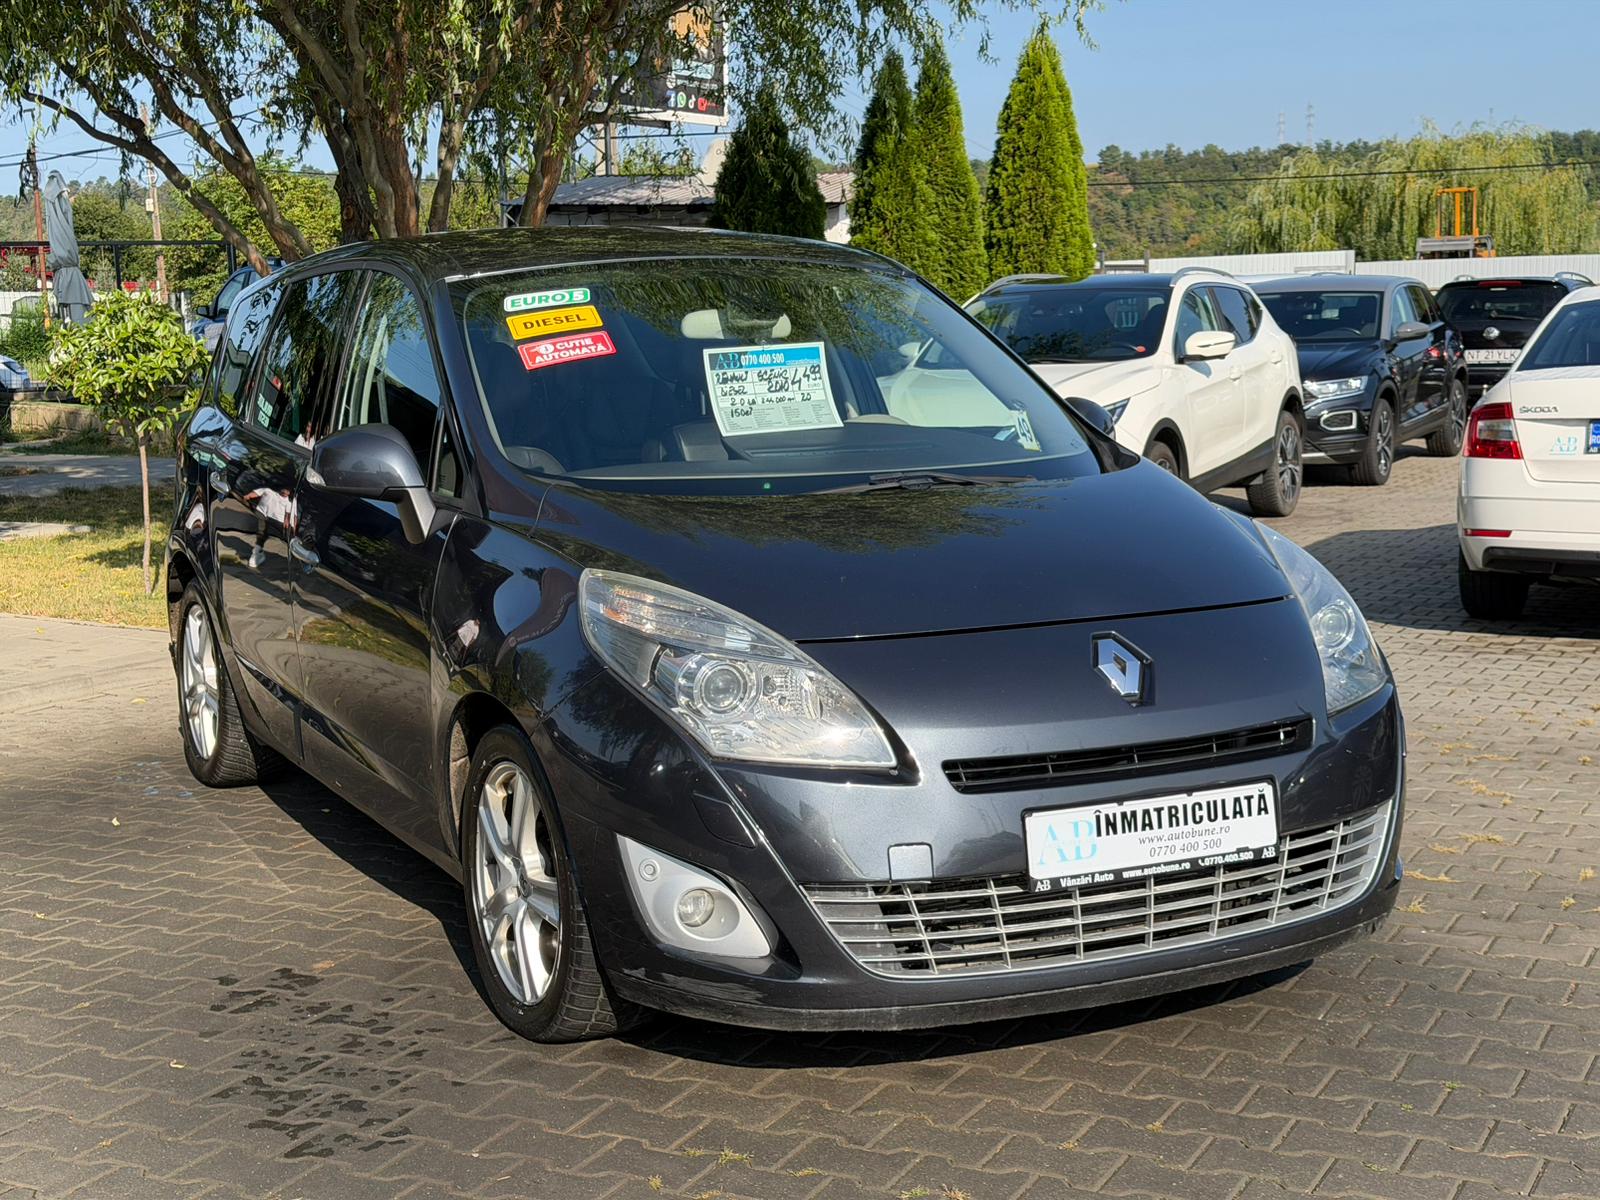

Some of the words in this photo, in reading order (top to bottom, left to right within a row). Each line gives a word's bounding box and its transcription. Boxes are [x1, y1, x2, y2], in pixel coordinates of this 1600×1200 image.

[511, 293, 567, 309] EURO
[523, 313, 587, 330] DIESEL
[535, 342, 607, 364] AUTOMATĂ
[556, 337, 594, 350] CUTIE
[715, 352, 741, 370] AB
[740, 354, 757, 366] 0770
[759, 353, 771, 365] 400
[772, 352, 785, 364] 500
[1092, 788, 1270, 838] ÎNMATRICULATĂ
[1037, 819, 1098, 865] AB
[1138, 825, 1231, 846] www.autobune.ro
[1149, 845, 1176, 858] 0770
[1179, 841, 1199, 854] 400
[1203, 837, 1222, 850] 500
[1034, 879, 1052, 893] AB
[1060, 873, 1093, 888] Vânzări
[1094, 871, 1114, 884] Auto
[1122, 861, 1191, 879] www.autobune.ro
[1204, 851, 1254, 866] 0770.400.500
[1261, 846, 1276, 859] AB
